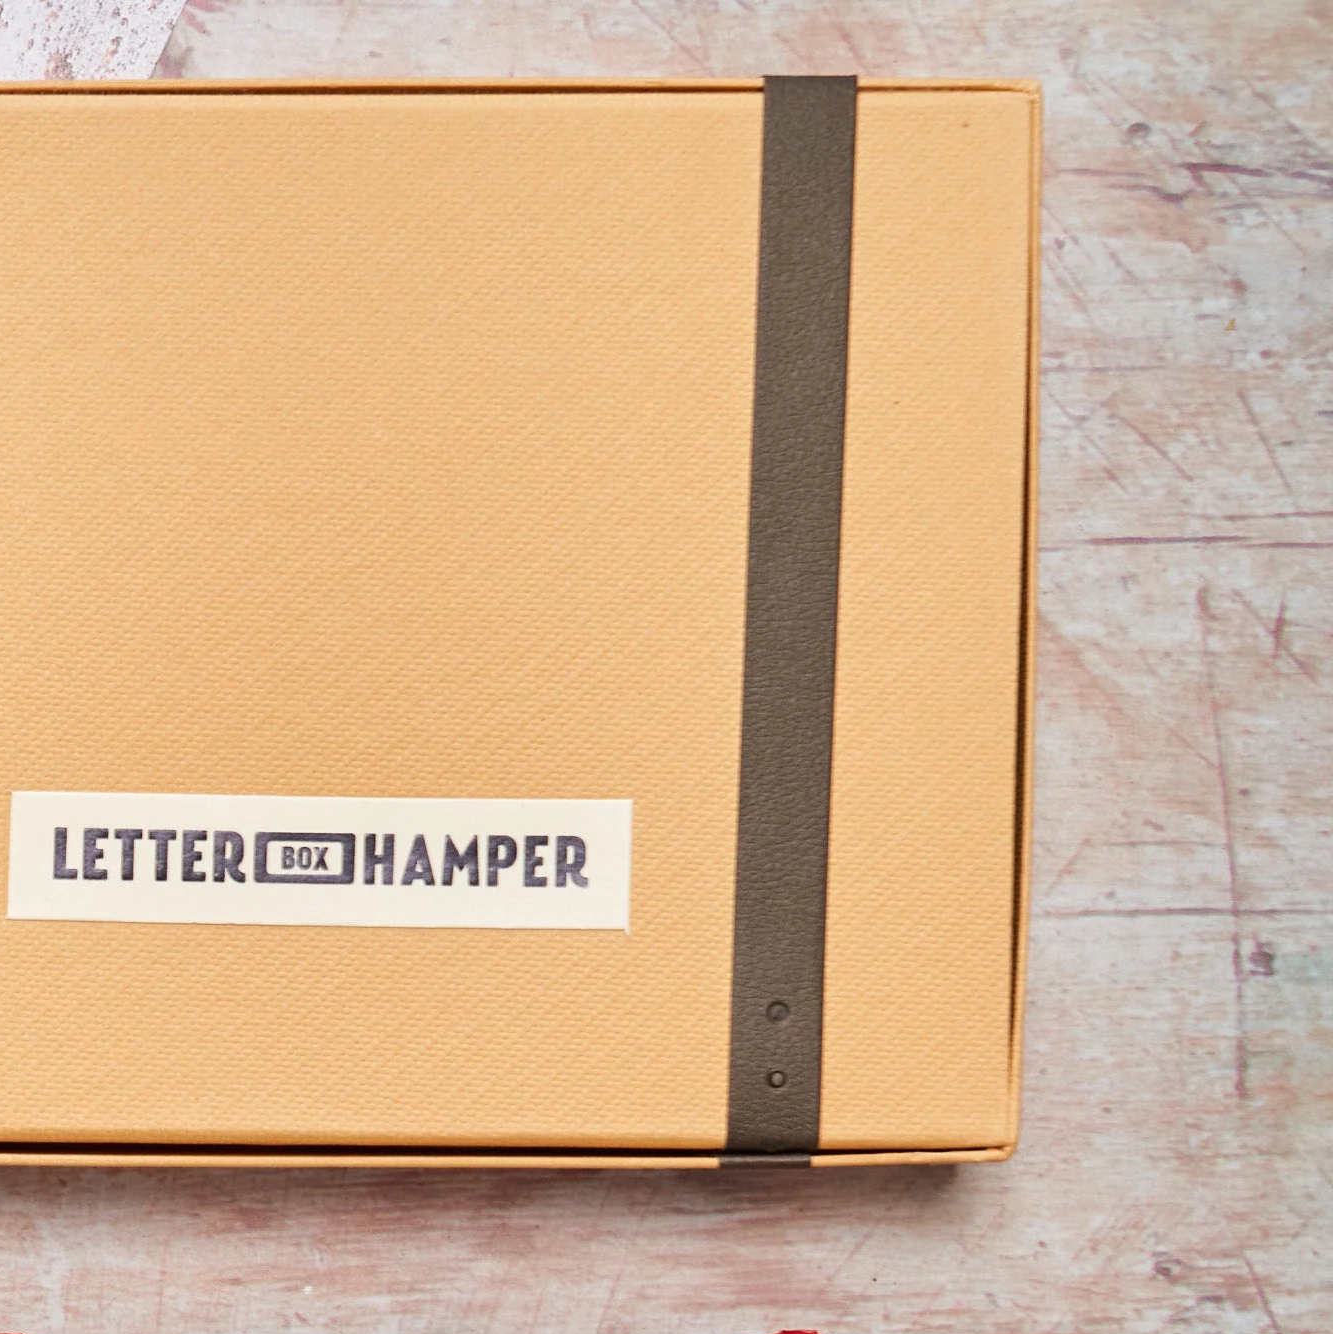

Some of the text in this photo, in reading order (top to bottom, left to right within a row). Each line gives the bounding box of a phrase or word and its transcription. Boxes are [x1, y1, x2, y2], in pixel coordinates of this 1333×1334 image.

[53, 827, 589, 889] LETTER BOX HAMPER
